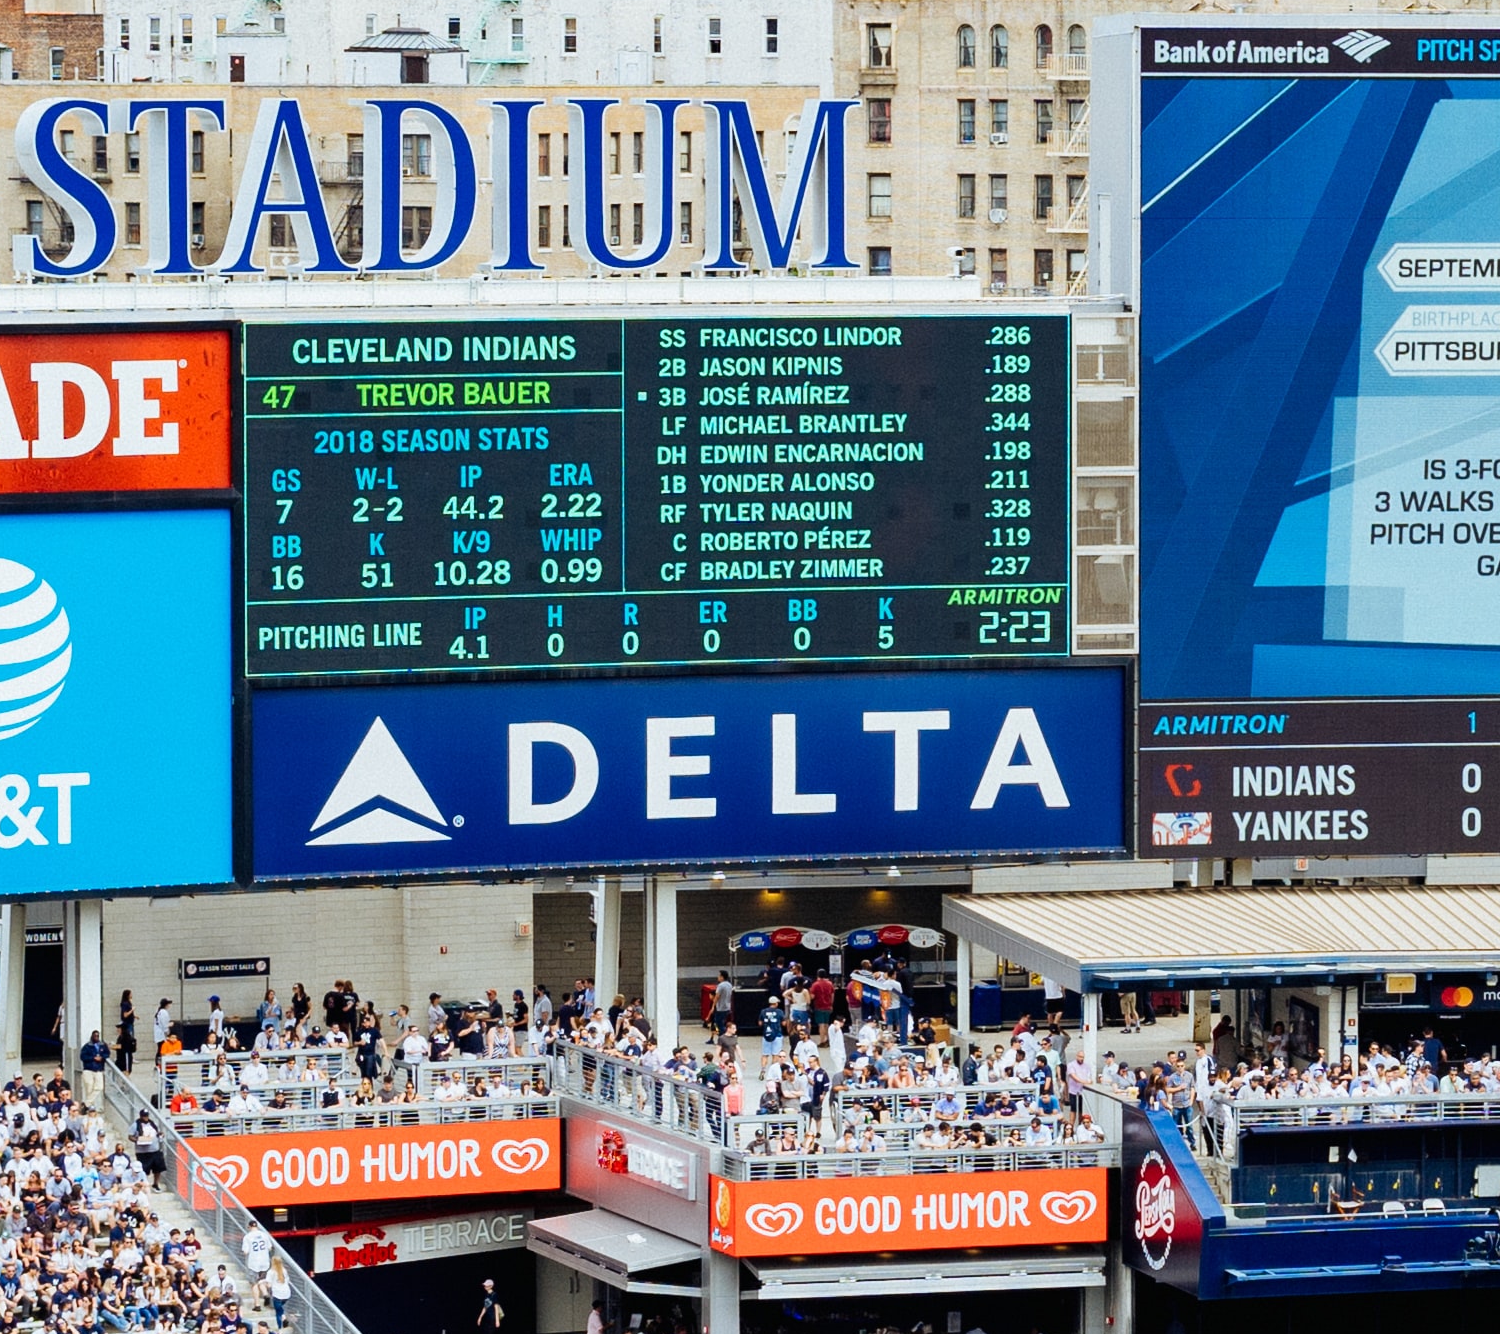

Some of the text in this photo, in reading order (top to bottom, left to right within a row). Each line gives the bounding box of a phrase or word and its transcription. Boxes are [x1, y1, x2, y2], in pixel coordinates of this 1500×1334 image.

[1155, 40, 1329, 63] Bank of America
[15, 97, 862, 275] STADIUM
[293, 336, 576, 363] CLEVELAND INDIANS
[700, 327, 901, 347] FRANCISCO LINDOR
[699, 381, 849, 405] JOSÉ RAMÍREZ
[259, 623, 422, 650] PITCHING LINE
[509, 708, 1070, 824] DELTA
[1233, 765, 1355, 796] INDIANS
[1233, 810, 1368, 841] YANKEES
[24, 933, 57, 942] WOMEN
[261, 1139, 482, 1189] GOOD HUMOR
[815, 1191, 1031, 1235] GOOD HUMOR
